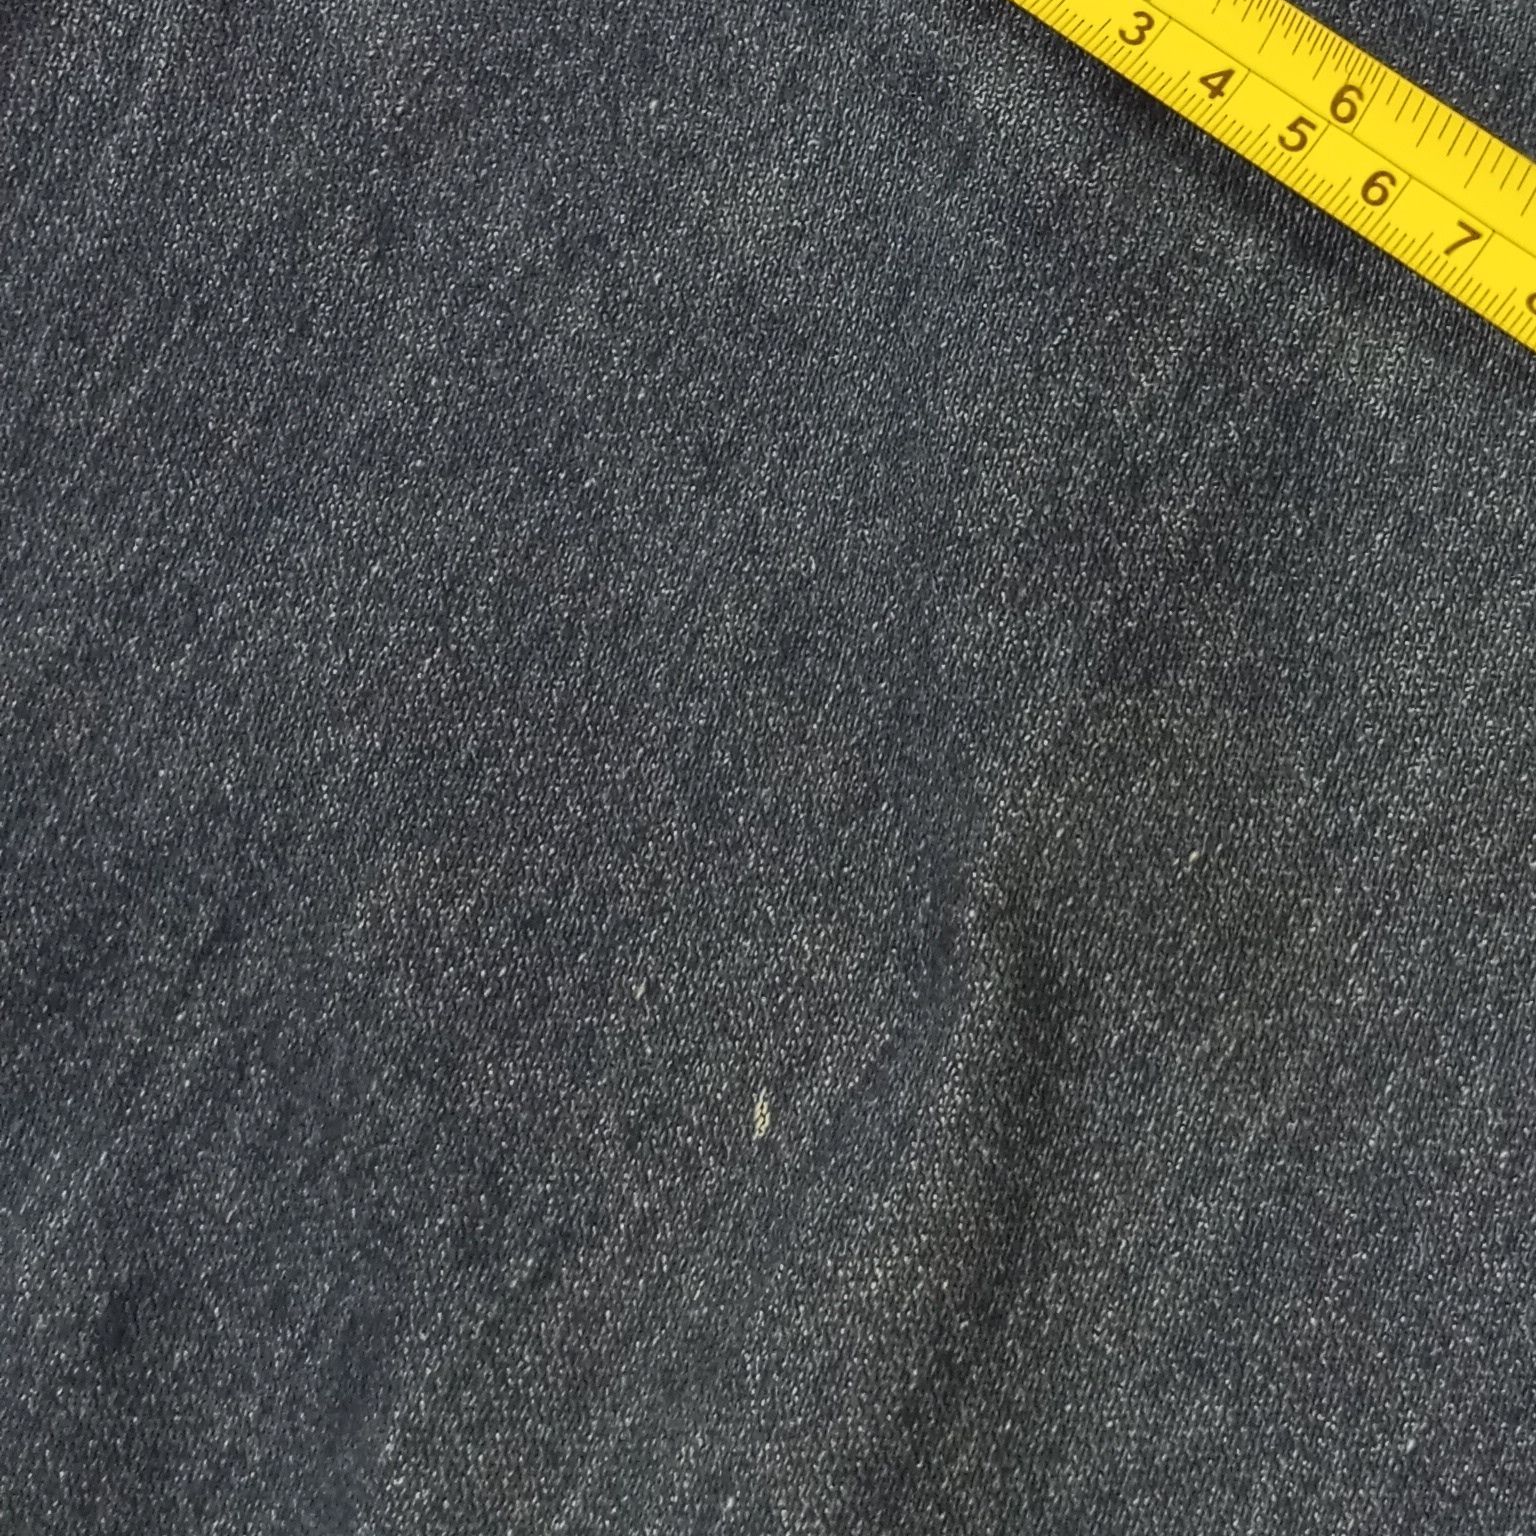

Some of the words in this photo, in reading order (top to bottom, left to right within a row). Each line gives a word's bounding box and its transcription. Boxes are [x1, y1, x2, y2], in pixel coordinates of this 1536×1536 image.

[1119, 11, 1155, 46] 3
[1199, 68, 1235, 100] 4
[1278, 116, 1316, 152] 5
[1361, 170, 1396, 207] 6
[1444, 220, 1483, 256] 7
[1330, 85, 1364, 124] 6
